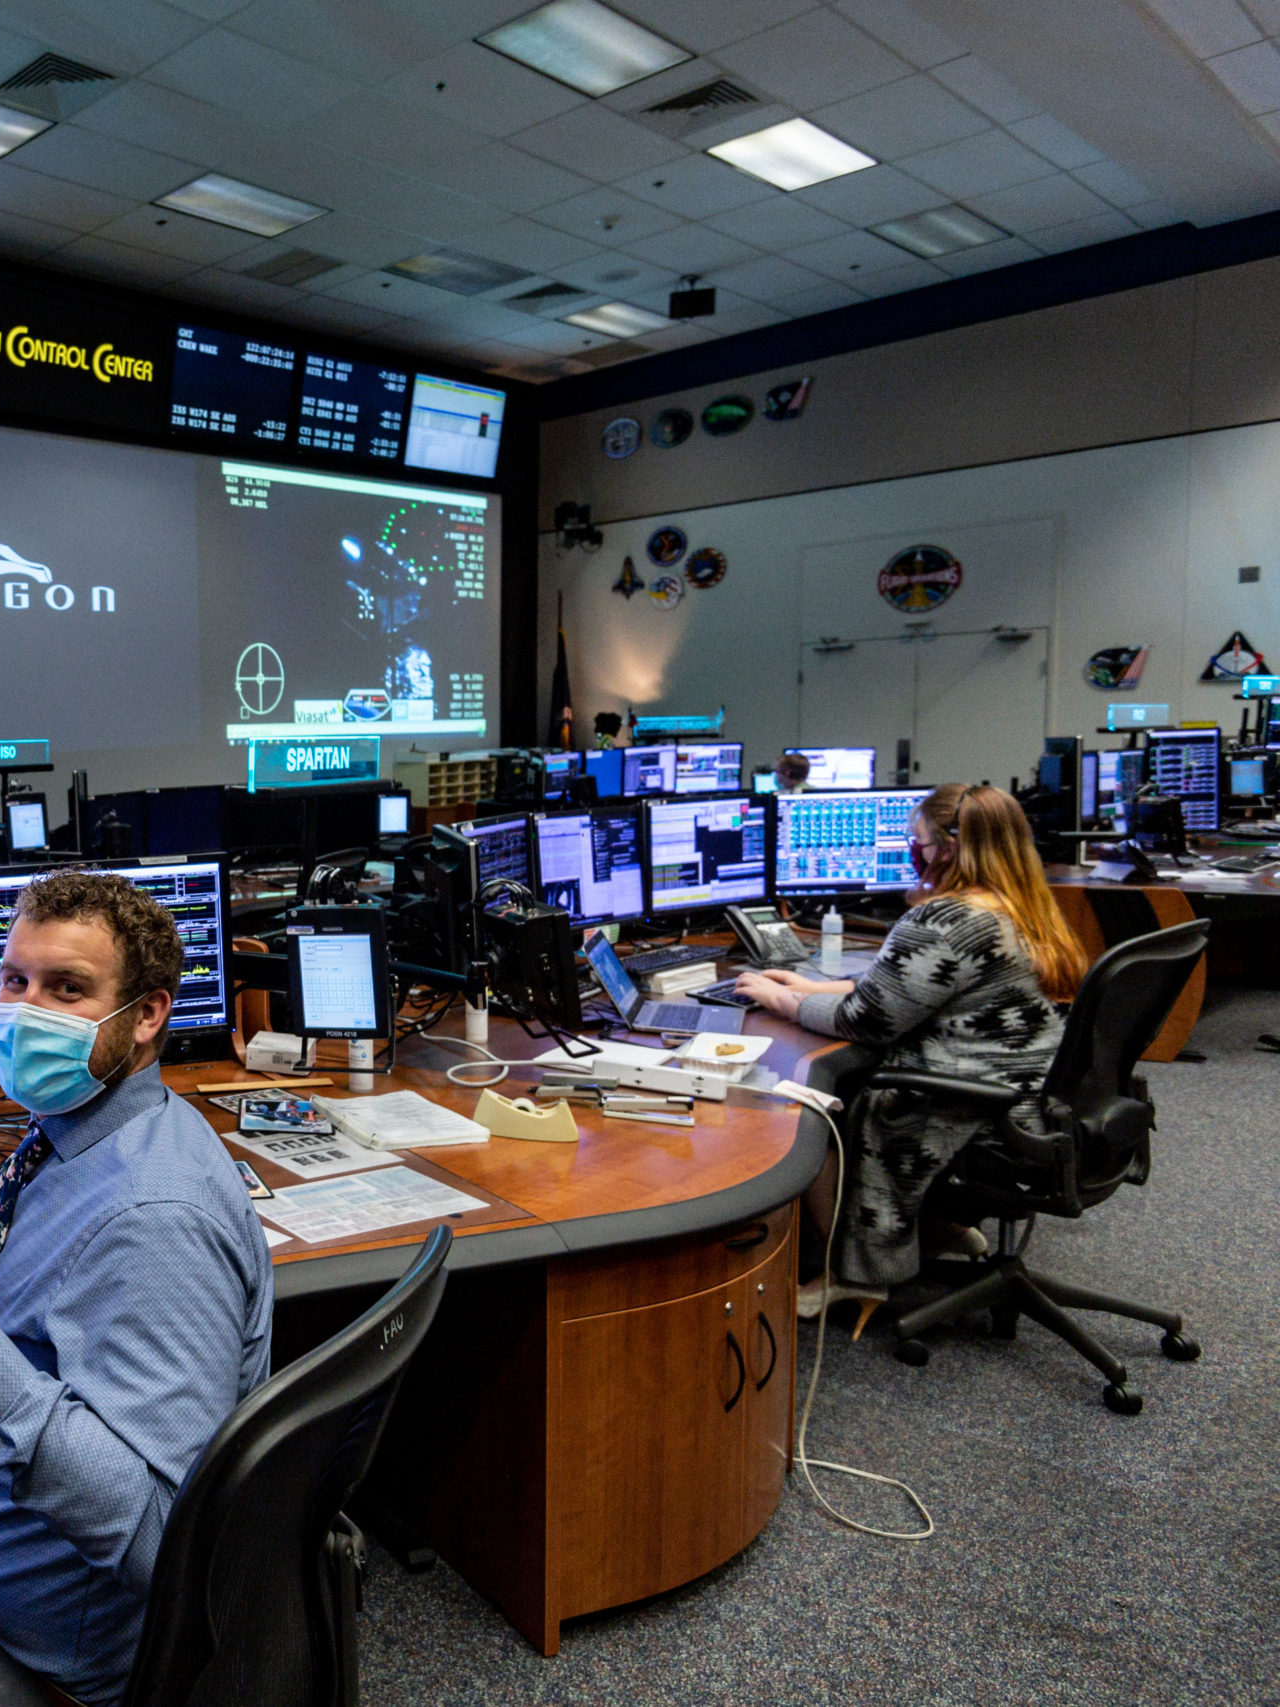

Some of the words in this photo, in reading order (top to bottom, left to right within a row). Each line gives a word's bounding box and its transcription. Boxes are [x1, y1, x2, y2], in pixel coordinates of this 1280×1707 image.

[296, 709, 329, 723] Viasat
[0, 745, 16, 760] ISO
[286, 746, 350, 773] SPARTAN
